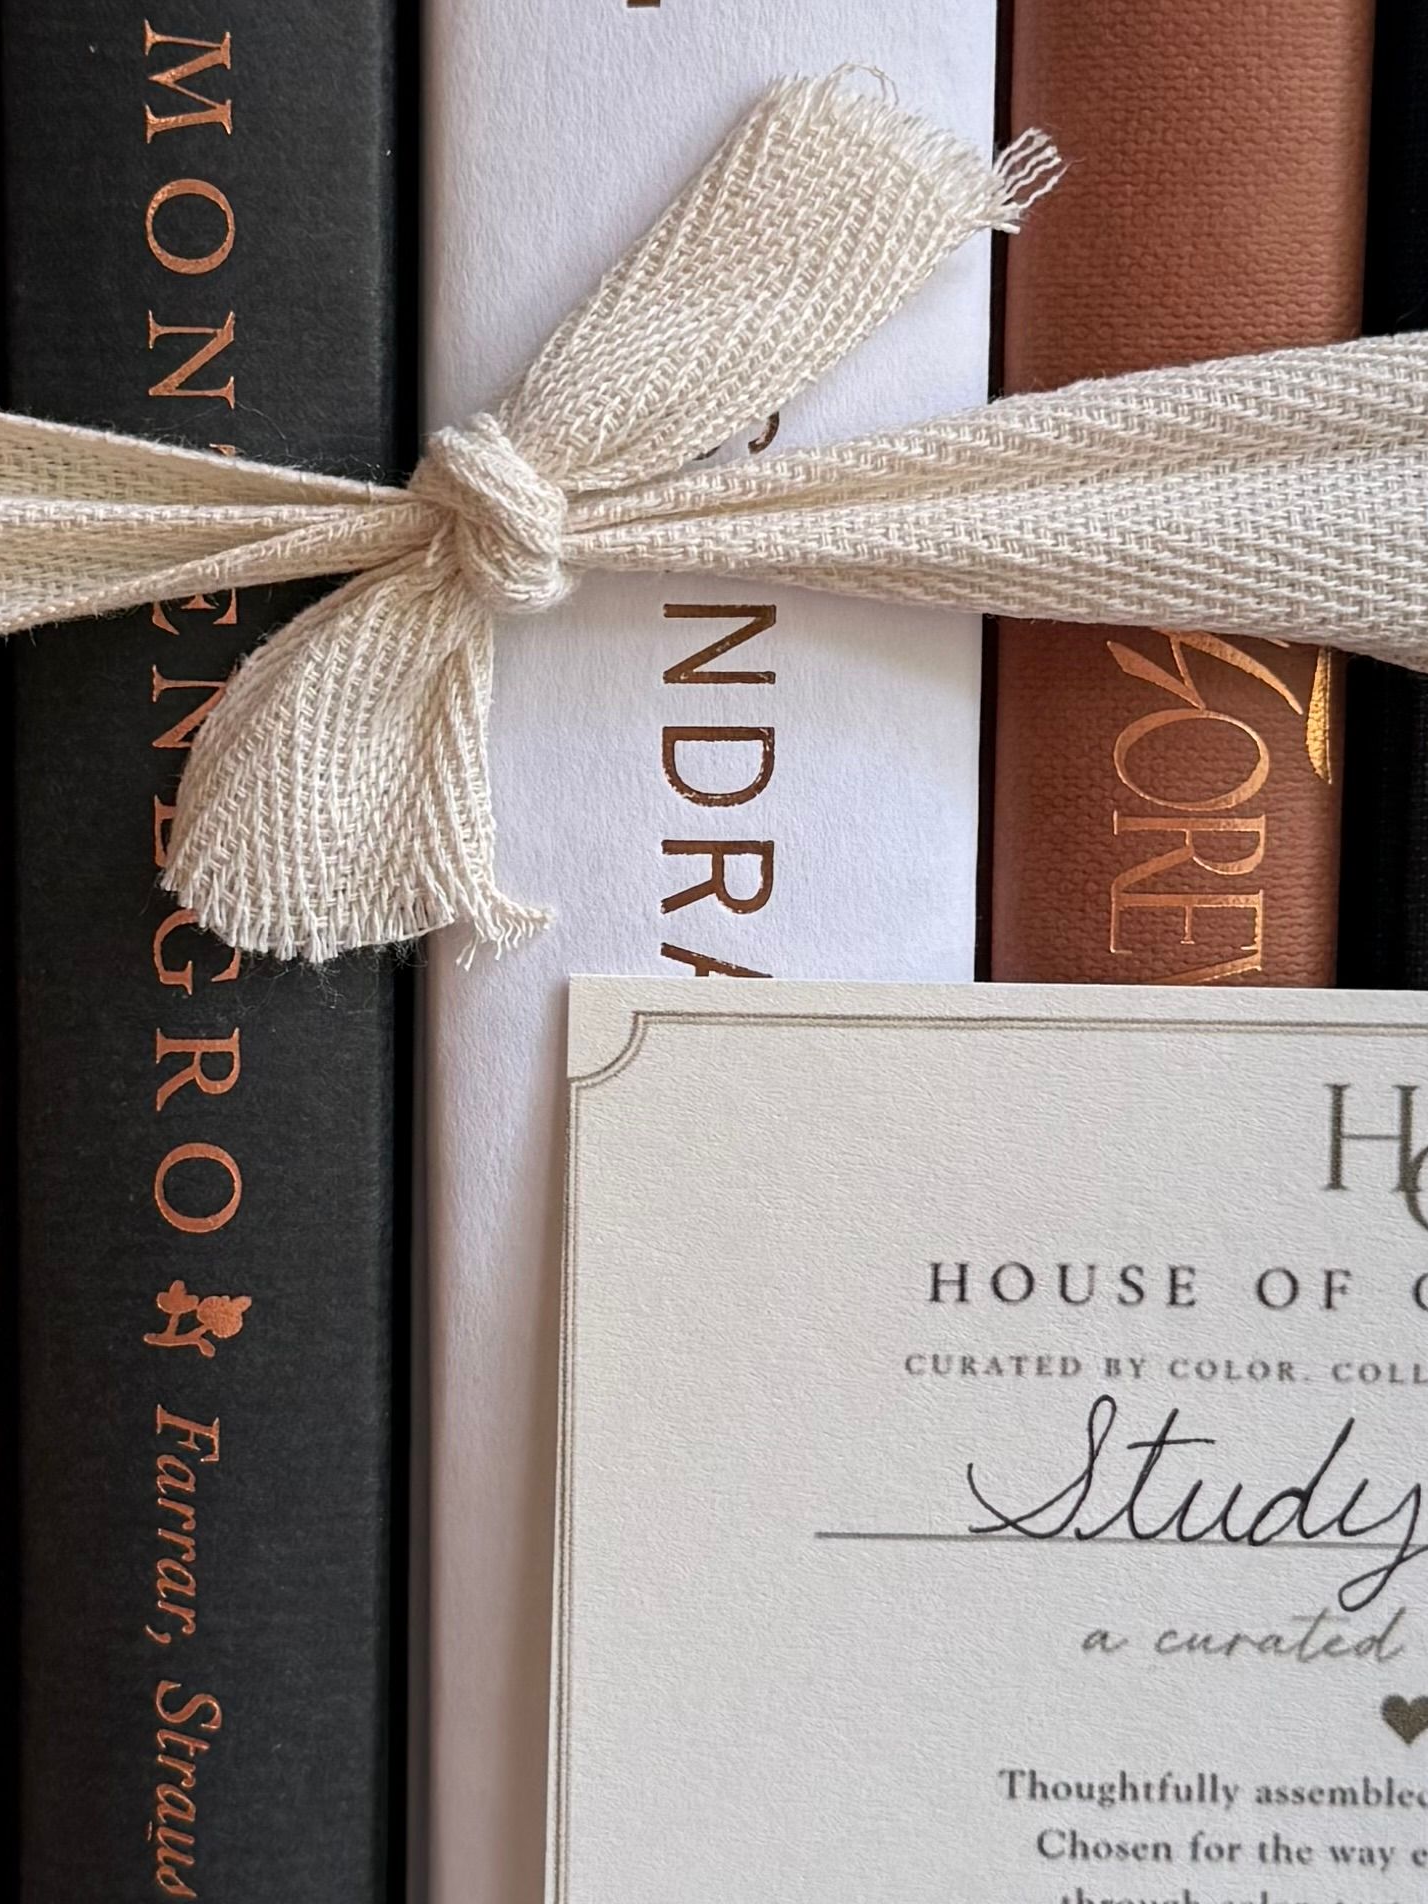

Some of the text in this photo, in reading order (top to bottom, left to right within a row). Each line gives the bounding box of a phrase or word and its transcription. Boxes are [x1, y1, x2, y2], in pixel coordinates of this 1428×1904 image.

[925, 1259, 1199, 1311] HOUSE
[1252, 1264, 1355, 1314] OF
[902, 1351, 1084, 1380] CURATED
[1102, 1355, 1148, 1382] BY
[1166, 1357, 1312, 1384] COLOR.
[145, 1406, 220, 1645] Farrar,
[1079, 1627, 1130, 1657] a
[1152, 1605, 1409, 1666] curated
[149, 1681, 223, 1898] Straus
[995, 1766, 1242, 1813] Thoughtfully
[1033, 1827, 1175, 1866] Chosen
[1187, 1828, 1245, 1866] for
[1255, 1830, 1315, 1868] the
[1326, 1843, 1397, 1876] way
